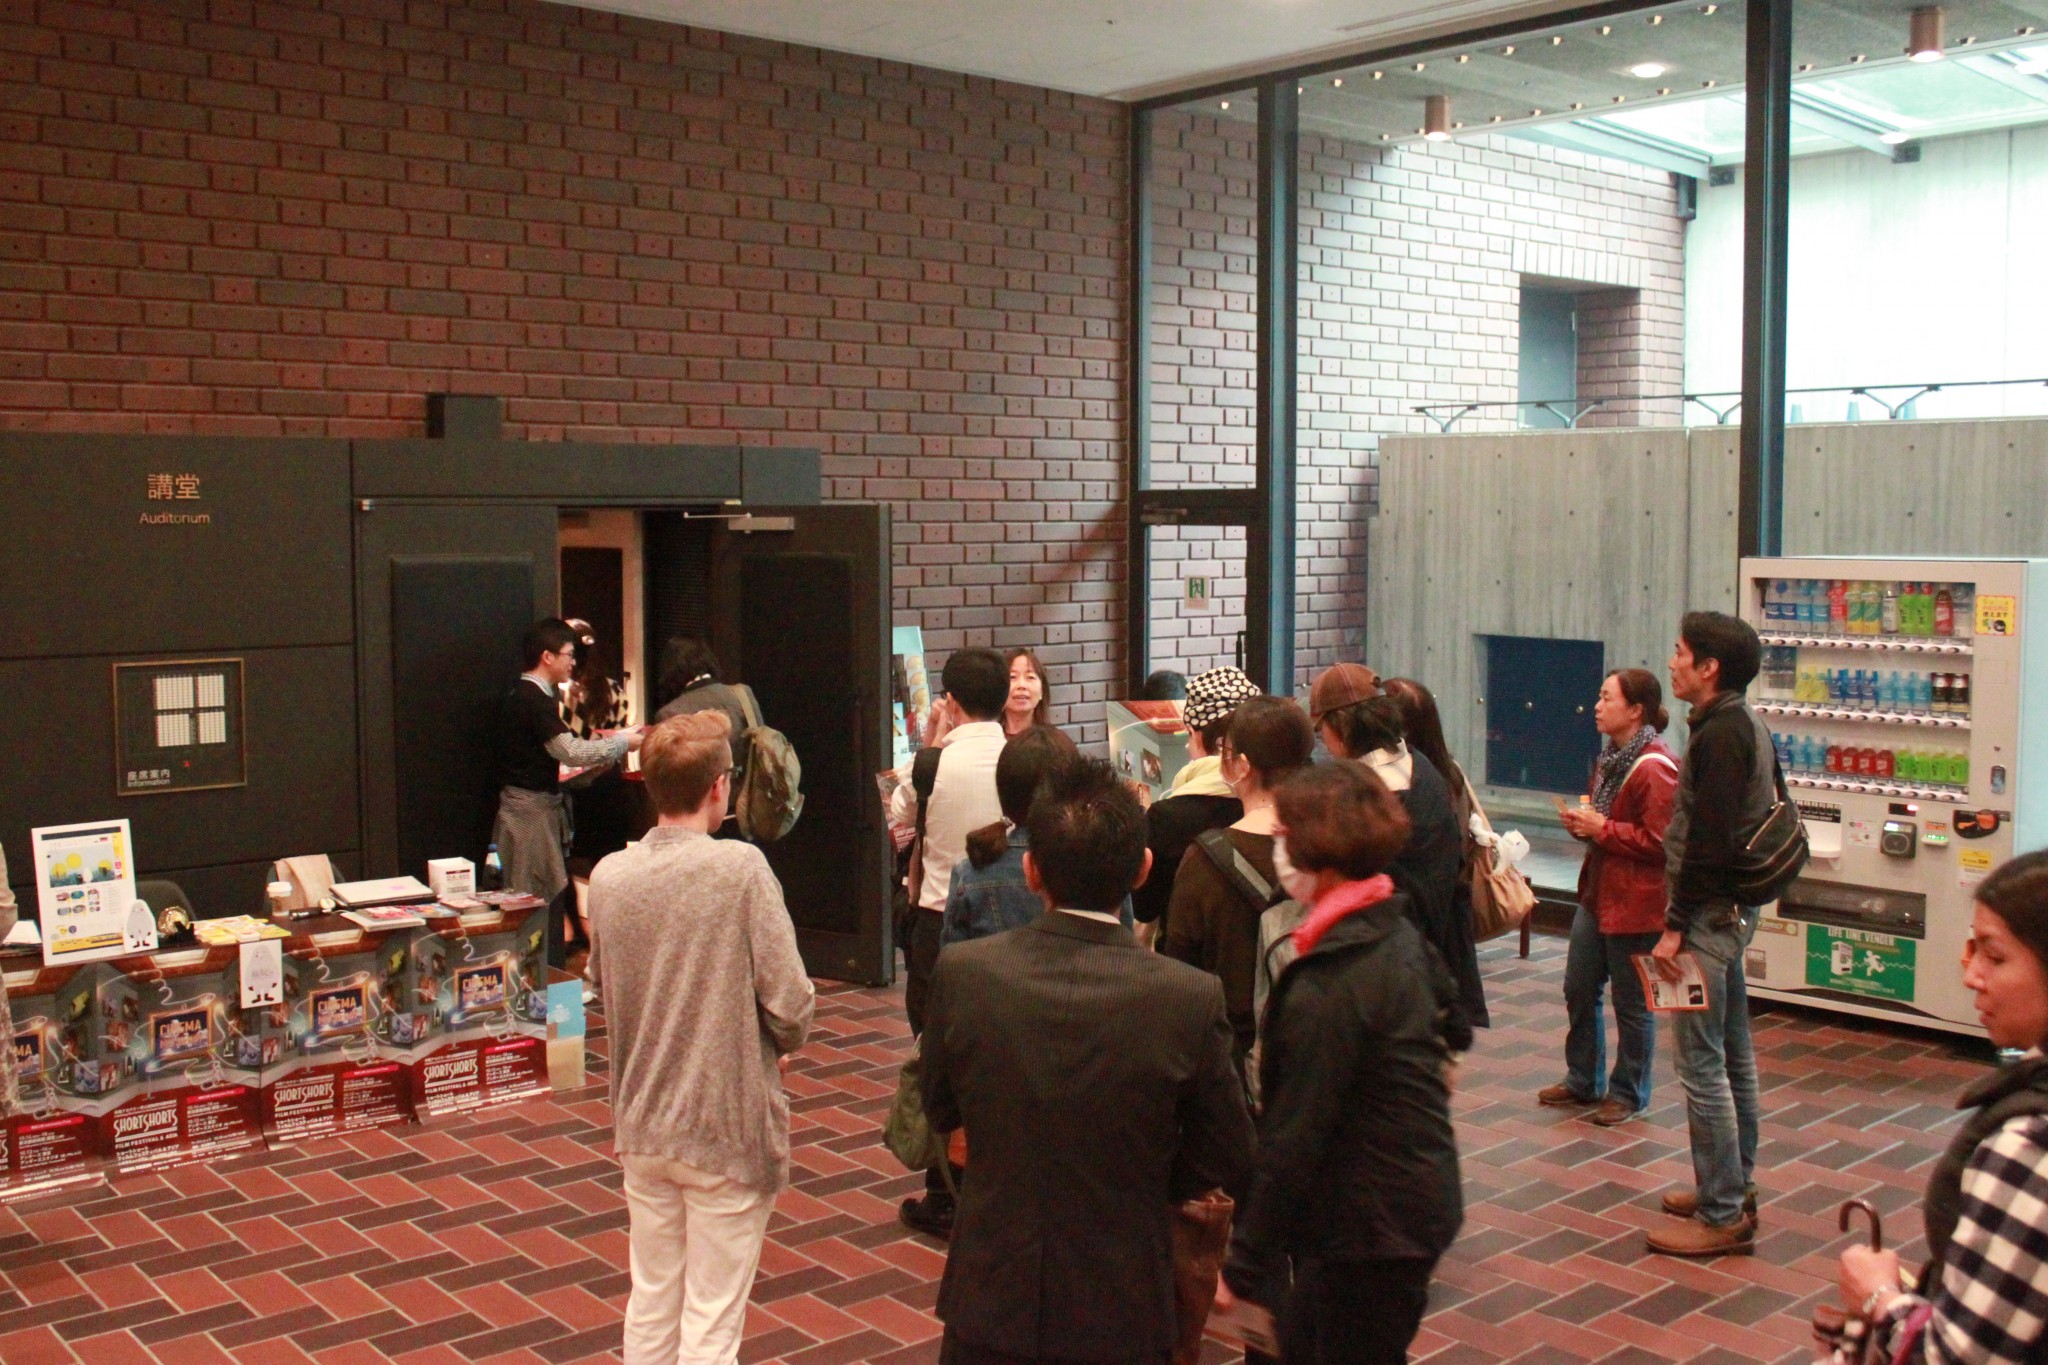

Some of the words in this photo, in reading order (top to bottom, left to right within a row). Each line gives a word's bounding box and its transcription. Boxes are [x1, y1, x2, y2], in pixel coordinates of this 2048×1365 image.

[147, 473, 201, 499] 講堂
[139, 512, 210, 524] Auditorium
[127, 779, 170, 787] Information
[1828, 927, 1843, 938] LIFE
[1846, 929, 1862, 941] LINE
[438, 1083, 462, 1092] FESTIVAL
[290, 1106, 315, 1116] FESTIVAL
[115, 1141, 130, 1150] FILM
[130, 1137, 159, 1147] FESTIVAL
